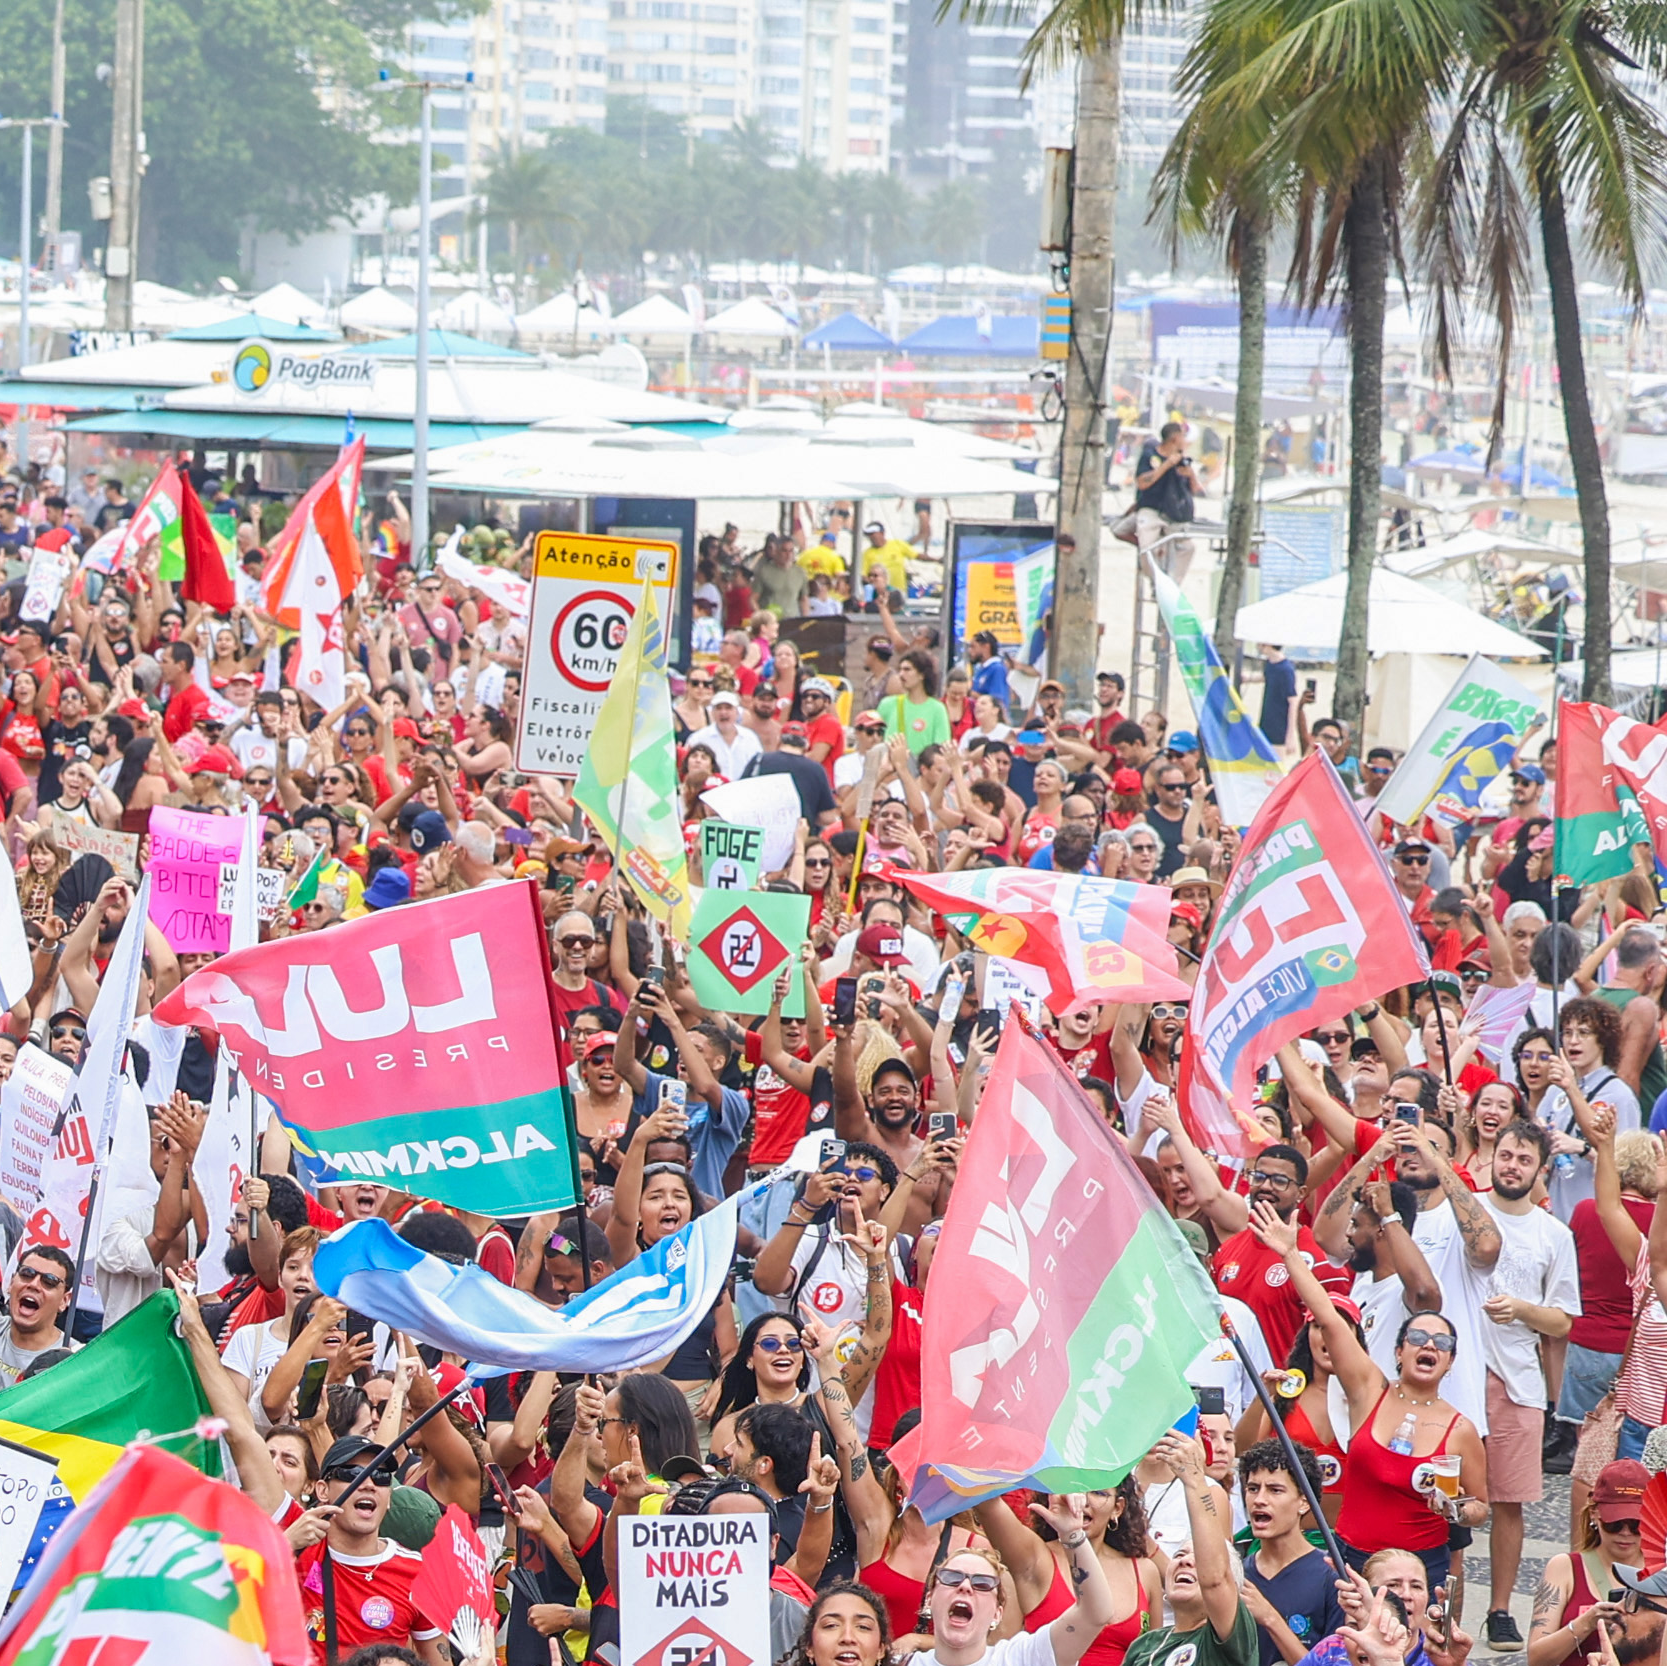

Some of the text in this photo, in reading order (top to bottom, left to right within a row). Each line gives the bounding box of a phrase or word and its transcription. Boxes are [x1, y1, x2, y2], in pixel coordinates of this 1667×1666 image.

[278, 357, 372, 387] PagBank
[543, 545, 631, 570] Atenção
[573, 612, 626, 650] 60
[570, 655, 617, 676] km/h
[173, 815, 213, 838] THE
[705, 826, 762, 863] FOGE
[11, 1139, 38, 1162] FAUNA
[817, 1287, 839, 1306] 13
[631, 1521, 759, 1549] DITADURA
[645, 1550, 743, 1579] NUNCA
[654, 1578, 731, 1608] MAIS
